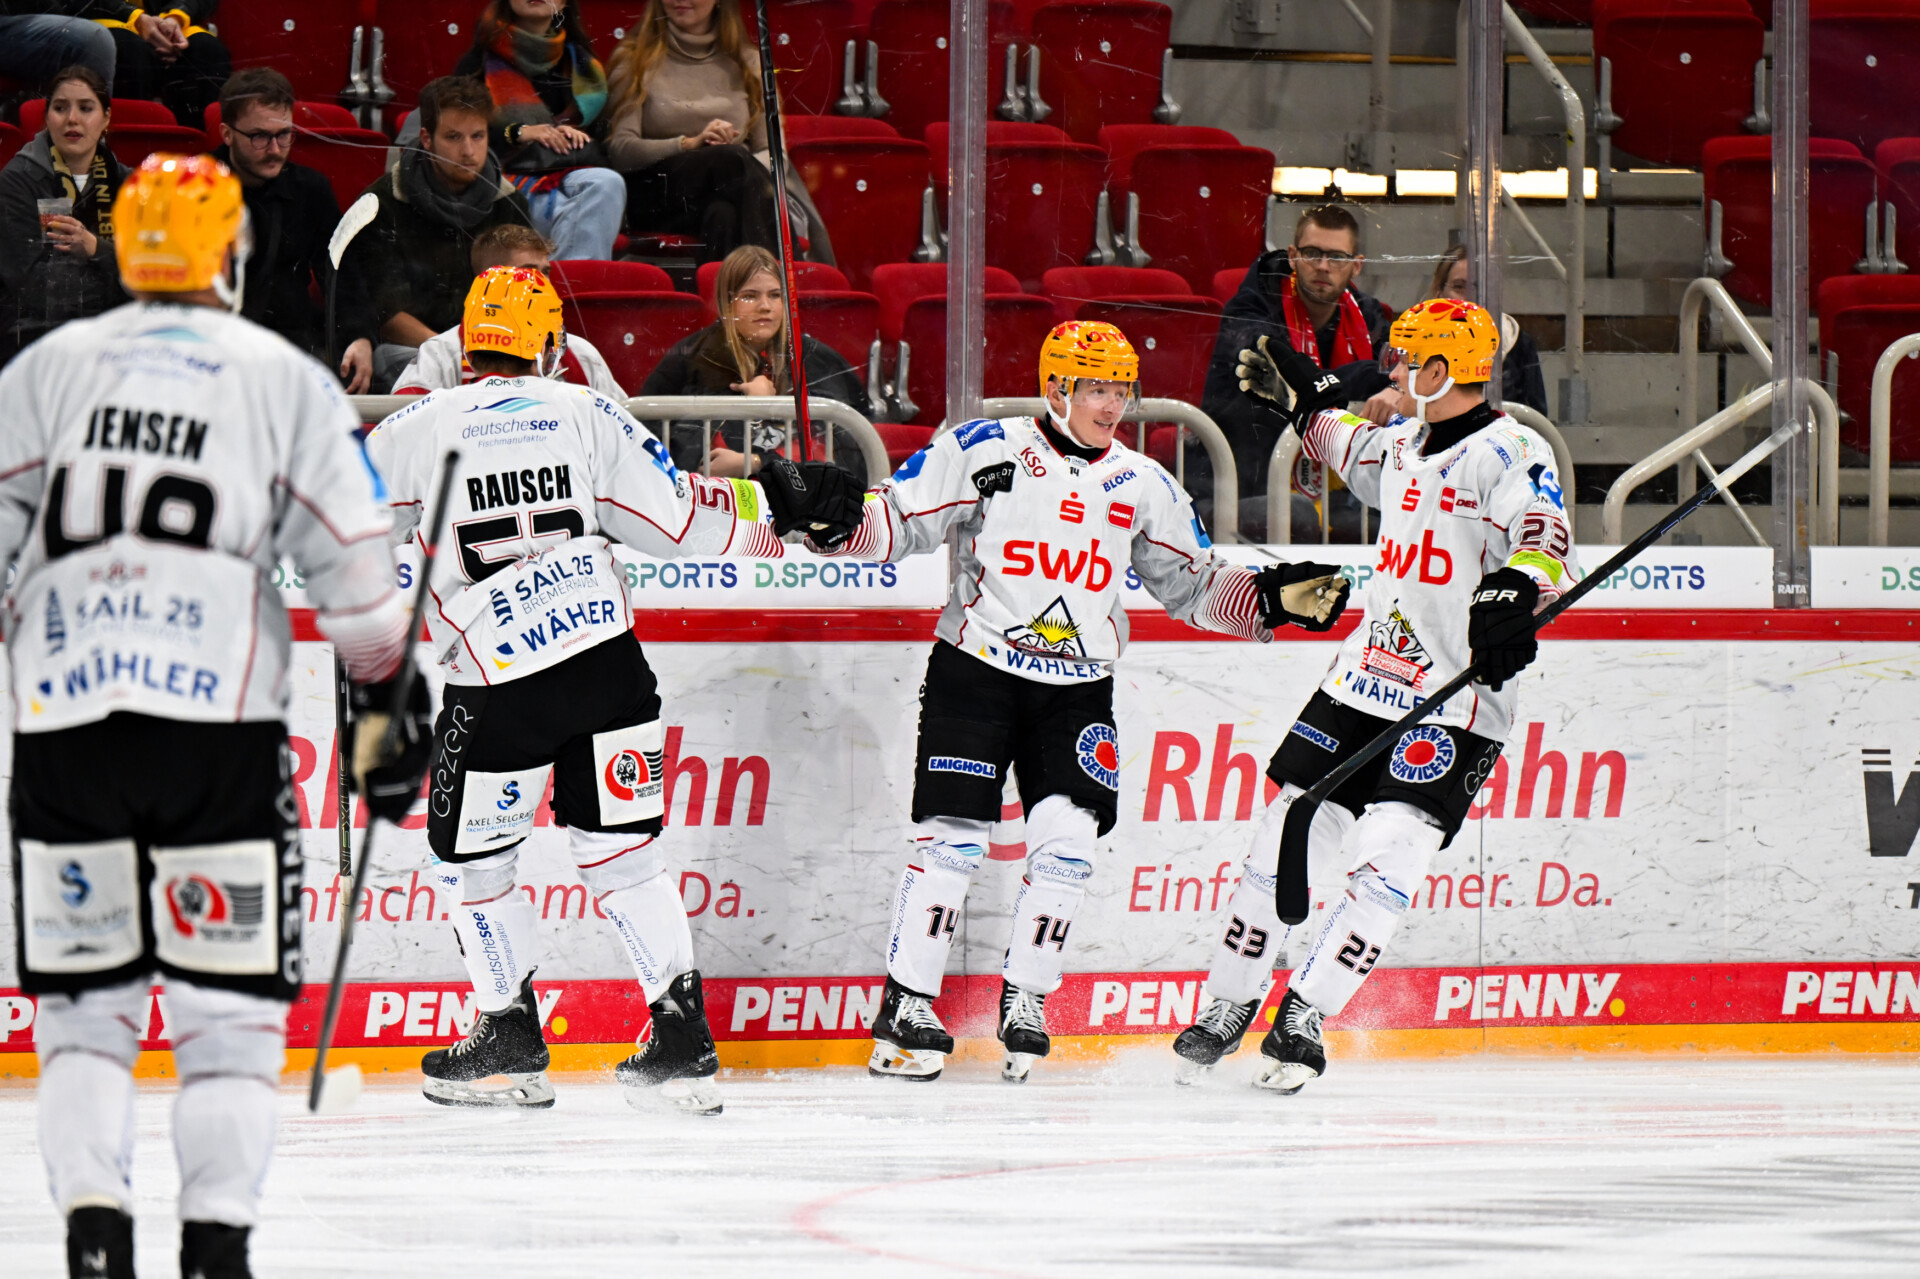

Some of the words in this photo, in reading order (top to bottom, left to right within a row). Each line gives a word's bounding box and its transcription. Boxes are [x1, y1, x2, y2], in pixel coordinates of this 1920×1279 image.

[485, 309, 496, 317] 53
[471, 332, 512, 347] LOTTO
[485, 378, 511, 388] AOK
[83, 406, 208, 462] JENSEN
[462, 418, 559, 440] deutschesee
[478, 434, 547, 449] Fischmanufaktur
[1020, 446, 1047, 478] KSO
[1069, 466, 1080, 477] 14
[467, 464, 573, 512] RAUSCH
[1102, 469, 1137, 493] BLOCH
[1518, 518, 1569, 559] 23
[572, 555, 594, 576] 25
[626, 562, 737, 589] SPORTS
[755, 562, 897, 589] D.SPORTS
[522, 576, 599, 615] BREMERHAVEN
[1777, 584, 1807, 595] RAITA
[520, 599, 616, 652] WÄHER
[1370, 657, 1411, 678] PINGUINS
[467, 818, 491, 827] AXEL
[1535, 862, 1612, 907] Da.
[926, 903, 960, 943] 14
[1032, 913, 1072, 953] 14
[1222, 913, 1269, 960] 23
[472, 911, 510, 996] deutschesee
[1334, 930, 1382, 976] 23
[1782, 971, 1920, 1015] PENN
